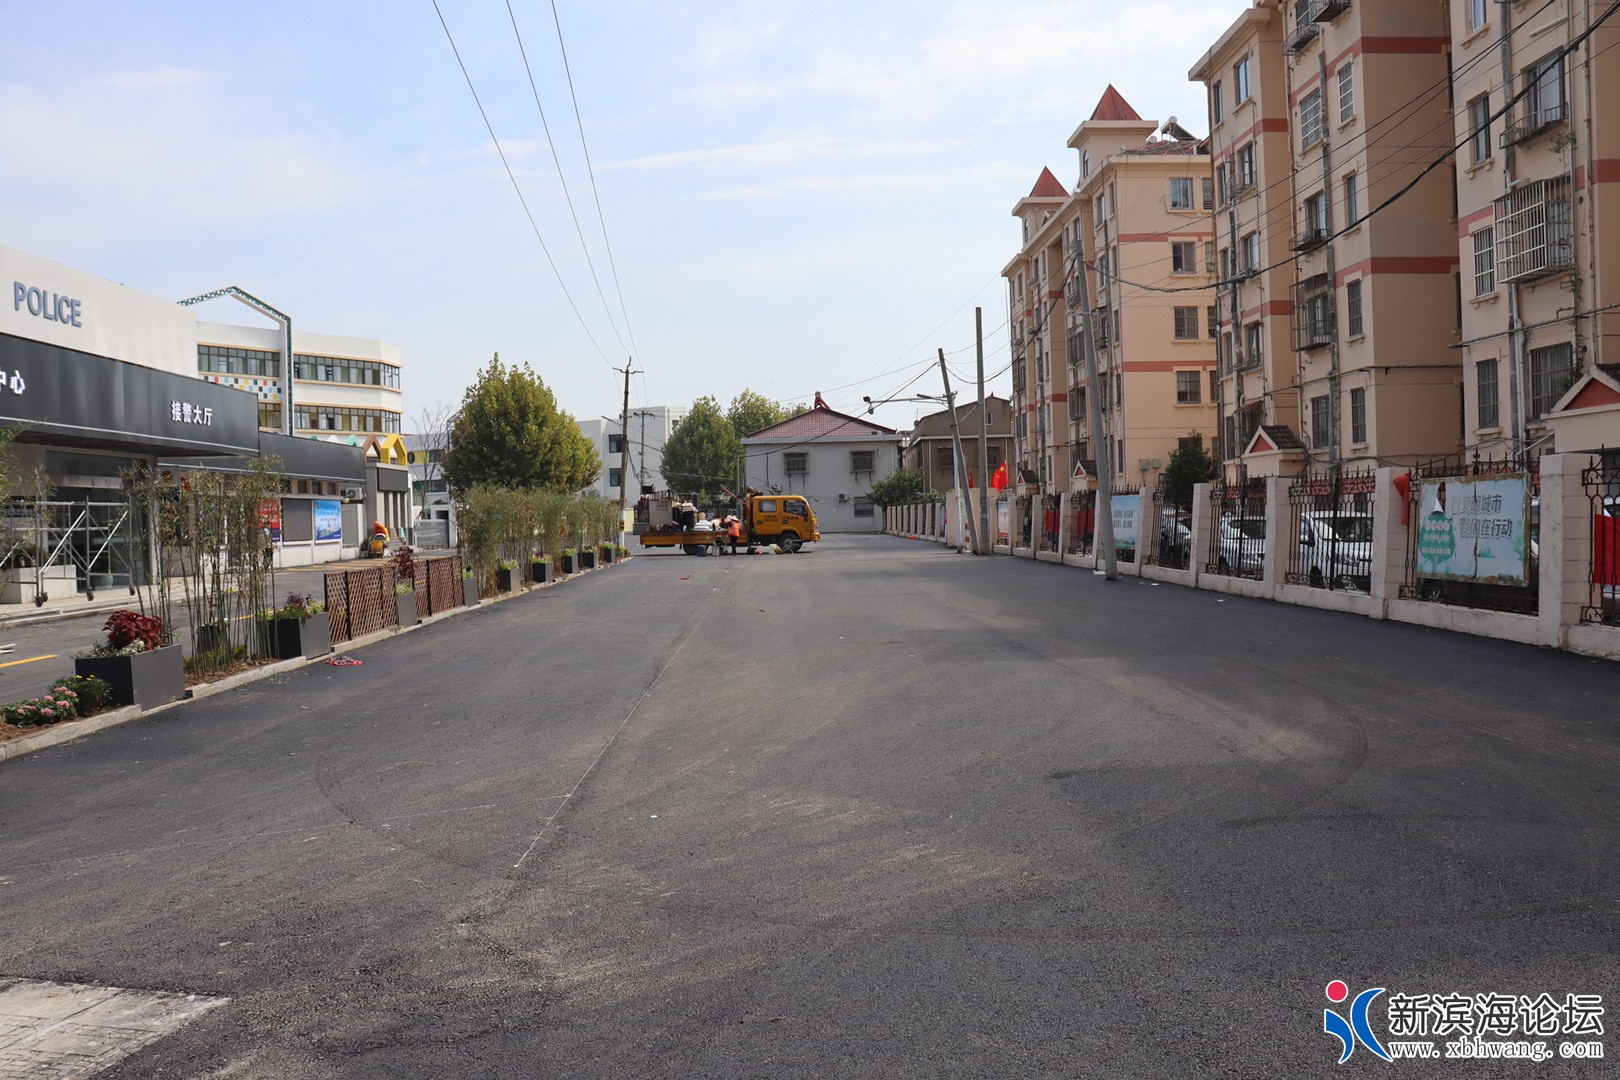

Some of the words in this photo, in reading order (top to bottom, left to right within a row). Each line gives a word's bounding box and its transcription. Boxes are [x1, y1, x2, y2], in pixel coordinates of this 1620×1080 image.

[14, 281, 82, 328] POLICE
[171, 400, 213, 426] 接警大厅
[1452, 493, 1503, 514] 文明城市
